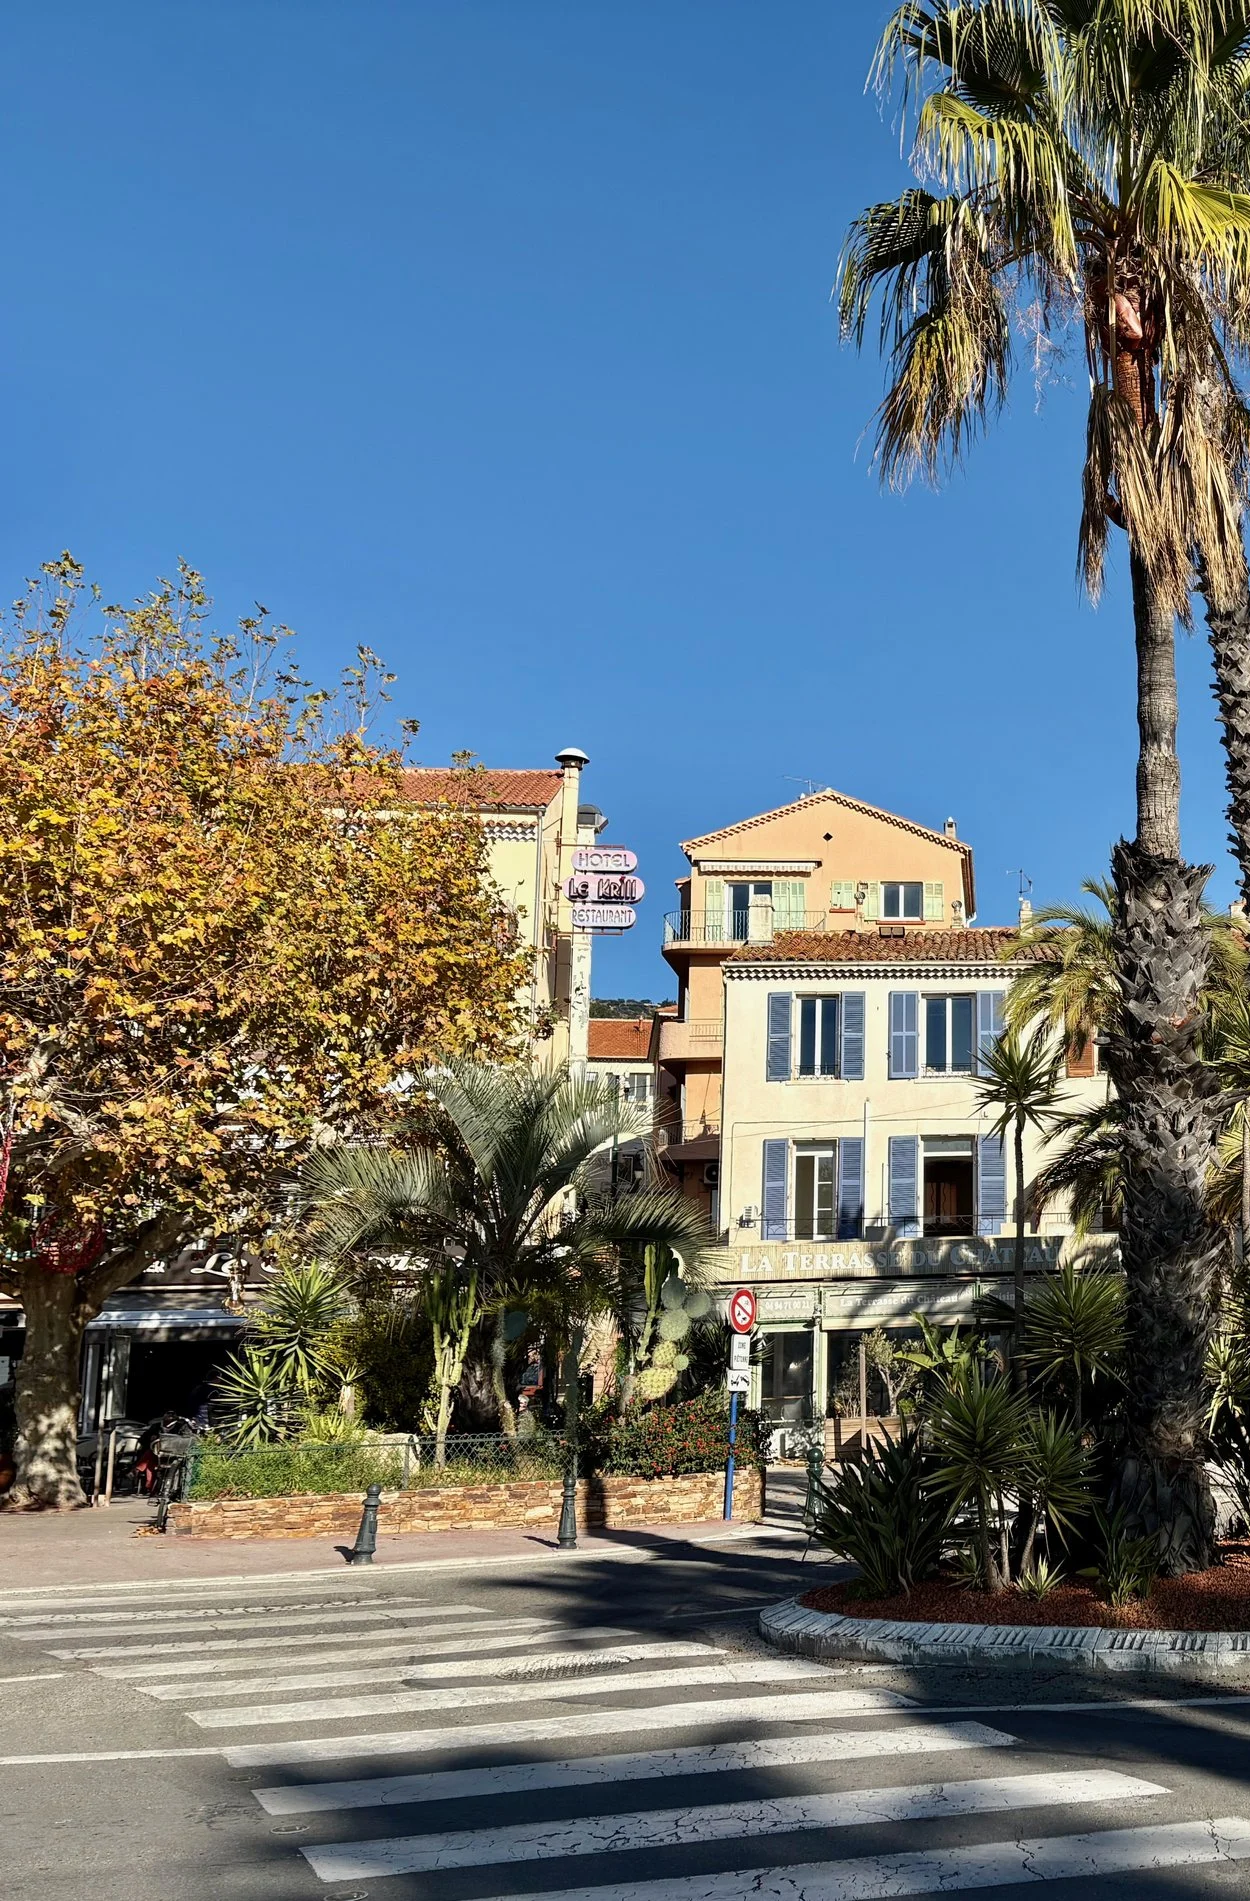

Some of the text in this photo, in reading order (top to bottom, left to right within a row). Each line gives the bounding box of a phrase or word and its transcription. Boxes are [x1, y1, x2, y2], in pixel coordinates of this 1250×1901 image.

[578, 852, 630, 867] HOTEL
[572, 909, 633, 923] RESTAURANT
[741, 1253, 773, 1273] LA
[782, 1251, 902, 1271] TERRASSE
[912, 1250, 942, 1267] DU
[840, 1298, 853, 1307] La
[856, 1297, 899, 1306] Terrasse
[901, 1295, 914, 1304] du
